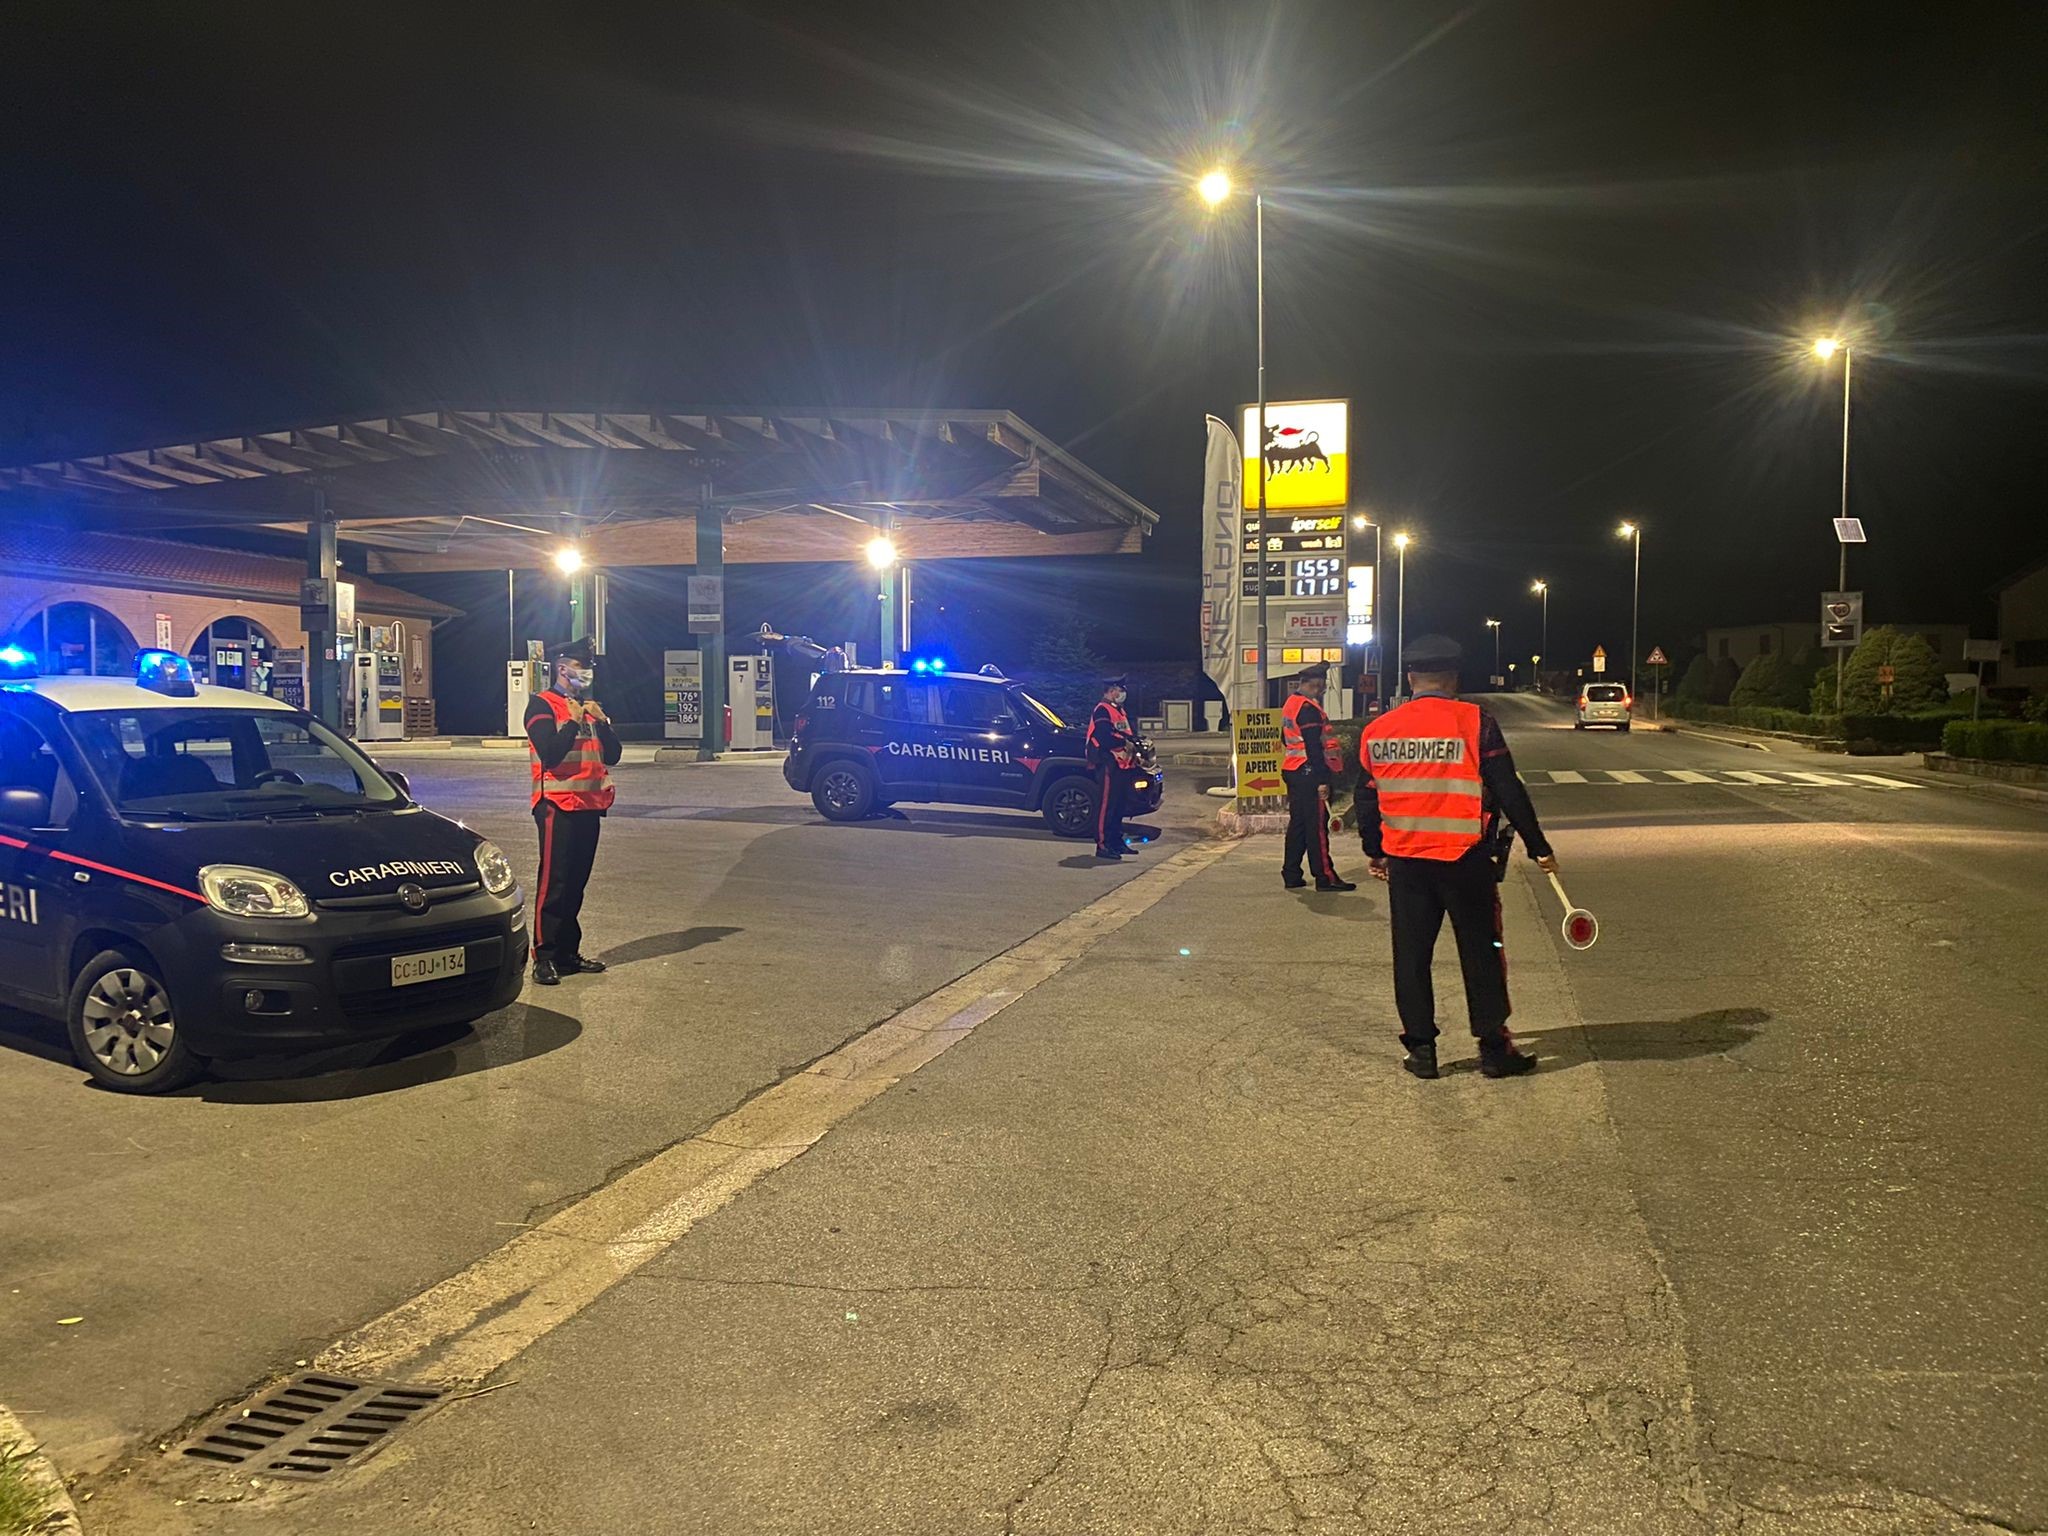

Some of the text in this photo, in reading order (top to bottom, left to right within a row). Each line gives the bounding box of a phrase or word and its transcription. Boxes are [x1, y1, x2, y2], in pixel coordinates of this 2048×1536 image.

[1291, 516, 1342, 533] iperself
[1290, 616, 1338, 627] PELLET
[739, 675, 744, 683] 7
[816, 696, 836, 707] 112
[1247, 713, 1271, 726] PISTE
[1239, 727, 1280, 740] AUTOLAVAGGIO
[888, 741, 1010, 764] CARABINIERI
[1238, 742, 1249, 755] SELF
[1250, 741, 1271, 754] SERVICE
[1372, 741, 1460, 760] CARABINIERI
[1245, 760, 1278, 774] APERTE
[329, 861, 465, 887] CARABINIERI
